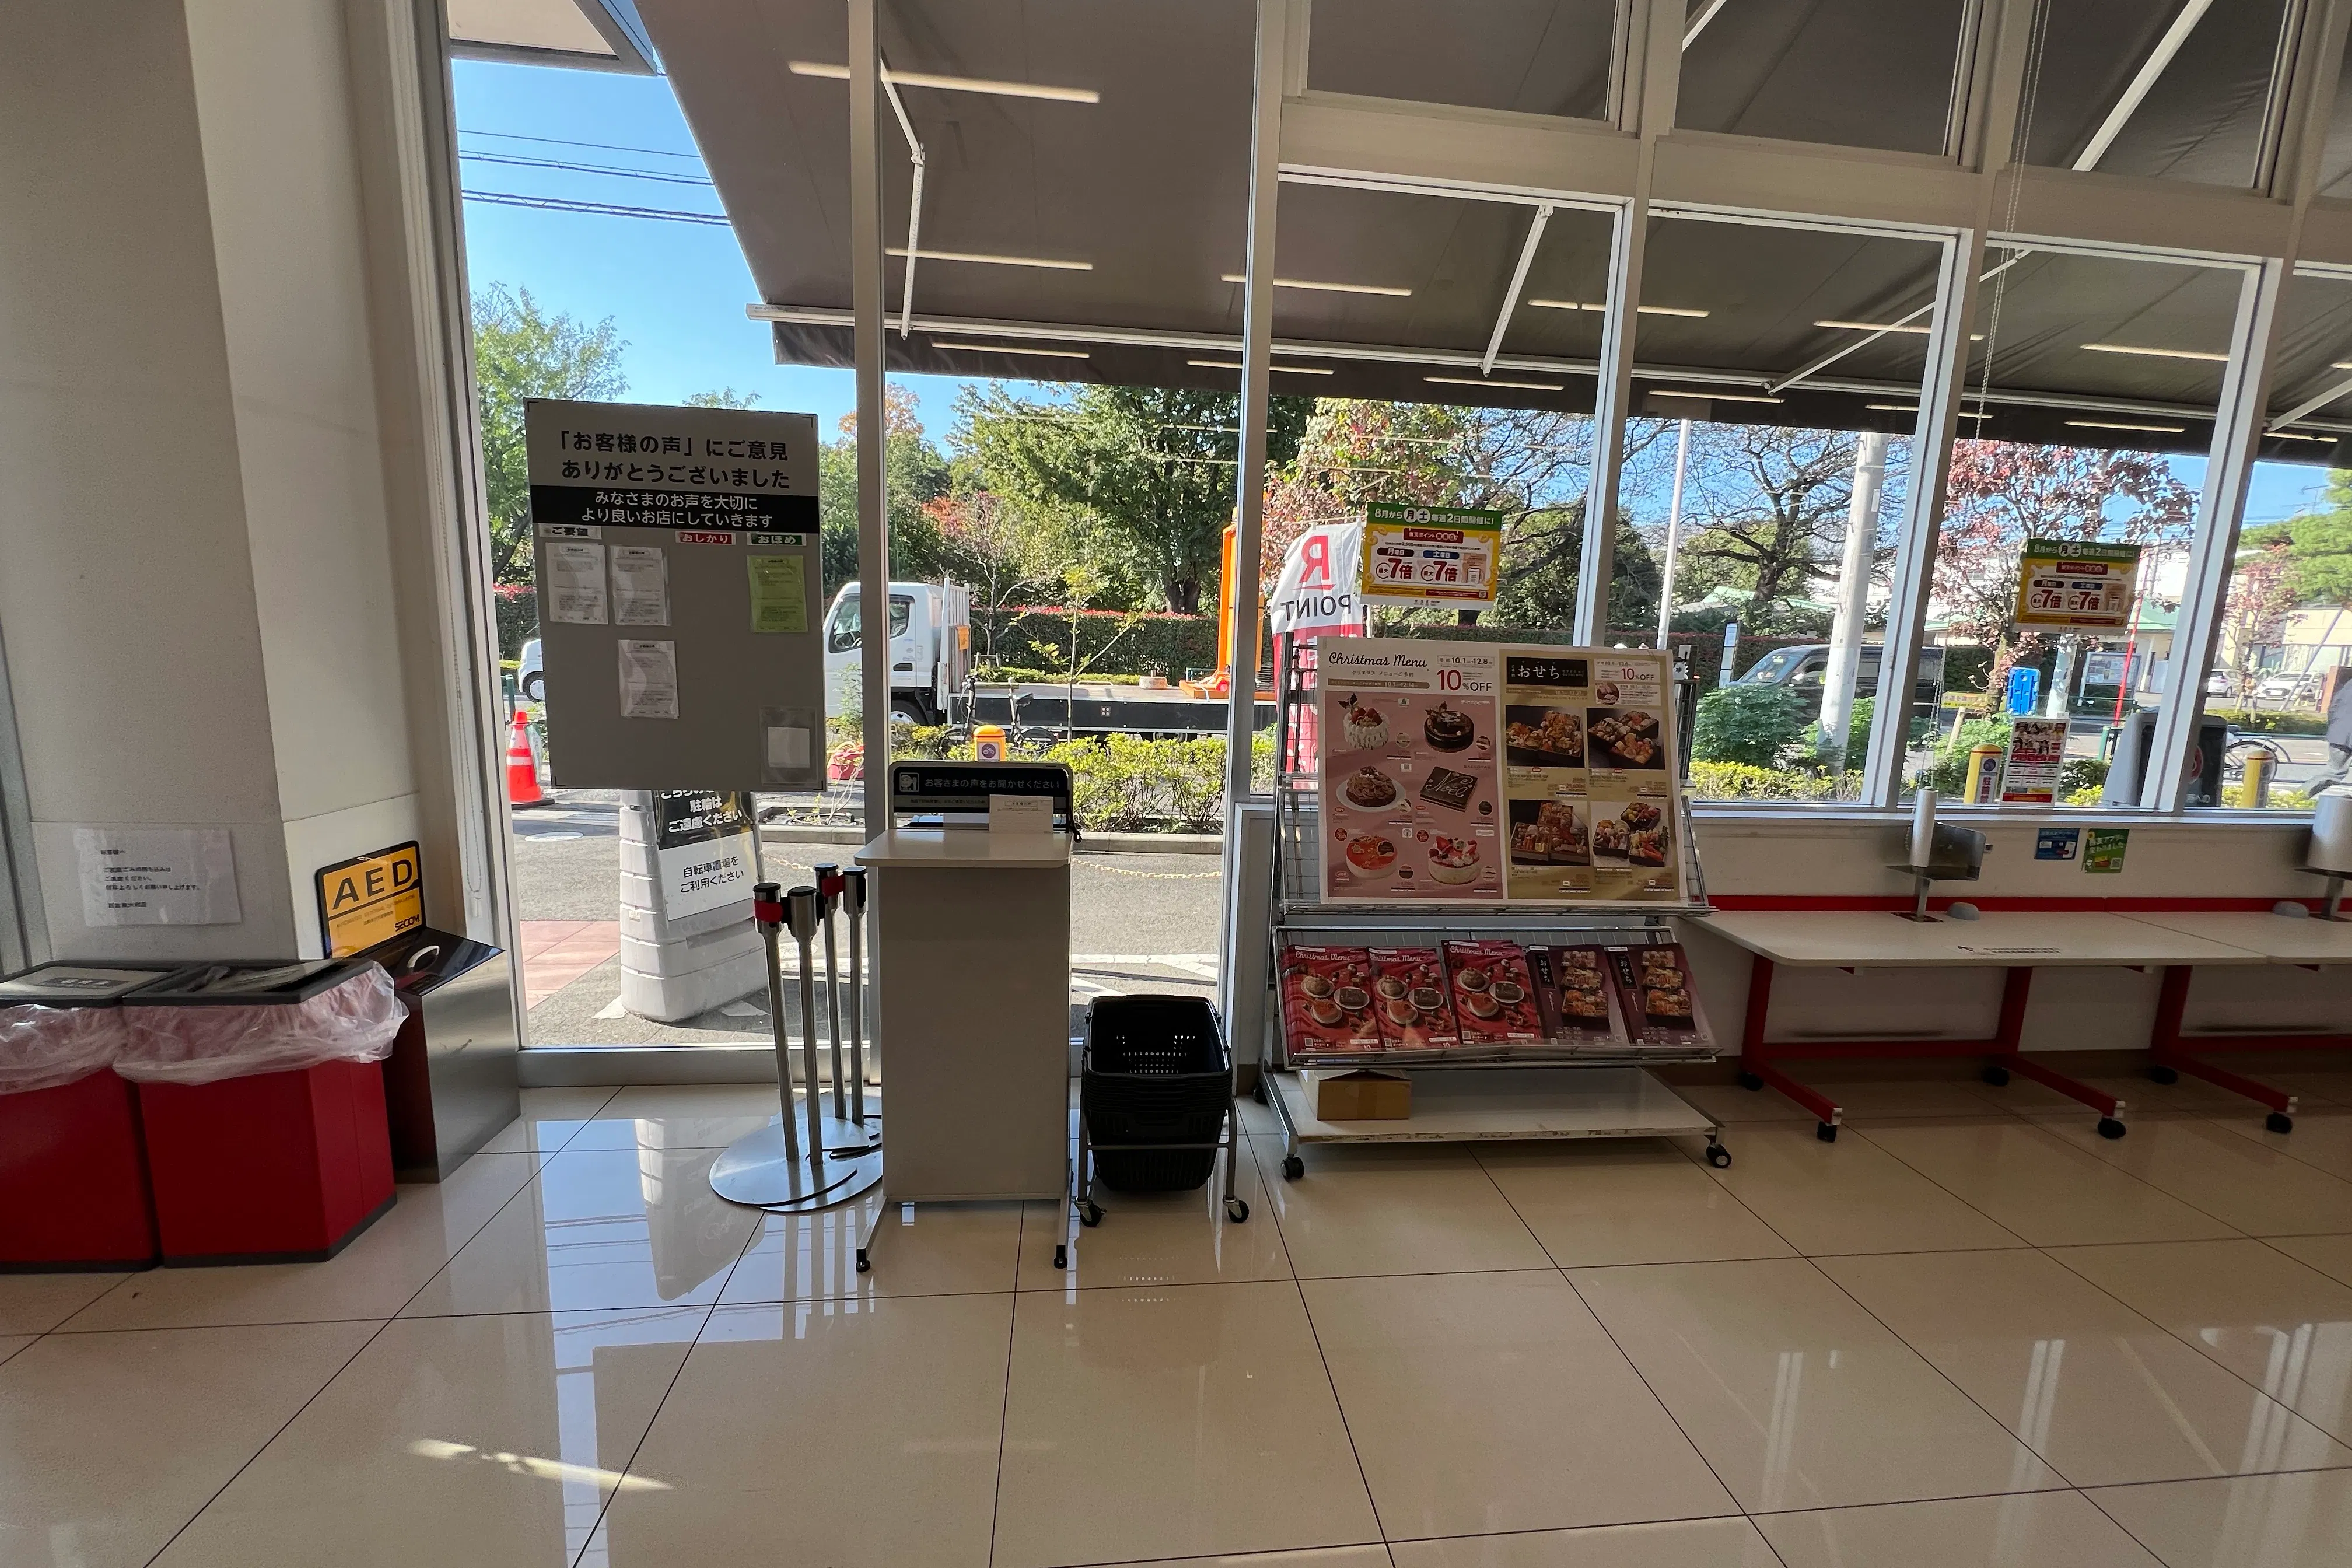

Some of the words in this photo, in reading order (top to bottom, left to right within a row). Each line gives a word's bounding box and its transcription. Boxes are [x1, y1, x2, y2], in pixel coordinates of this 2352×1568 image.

[561, 430, 788, 461] 「お客様の声」にご意見
[562, 460, 790, 489] ありがとうございました
[596, 491, 758, 511] みなさまのお声を大切に
[582, 508, 773, 528] より良いお店にしていきます
[682, 533, 729, 544] おしかり
[758, 534, 796, 545] おほめ
[1329, 652, 1390, 666] Christmas
[1393, 654, 1427, 667] Menu
[1517, 665, 1559, 680] おせち
[925, 779, 1060, 789] お客さまの声をお聞かせください
[690, 796, 722, 813] 駐輪は
[668, 810, 743, 832] ご遠慮ください
[683, 856, 739, 878] 自転車置場を
[332, 859, 413, 910] AED
[681, 870, 744, 893] ご利用ください
[1295, 951, 1329, 961] Christmas
[1330, 953, 1350, 961] Menu
[1369, 953, 1400, 962] Christmas
[1402, 954, 1422, 963] Menu
[1450, 946, 1483, 956] Christmas
[1483, 948, 1503, 957] Menu
